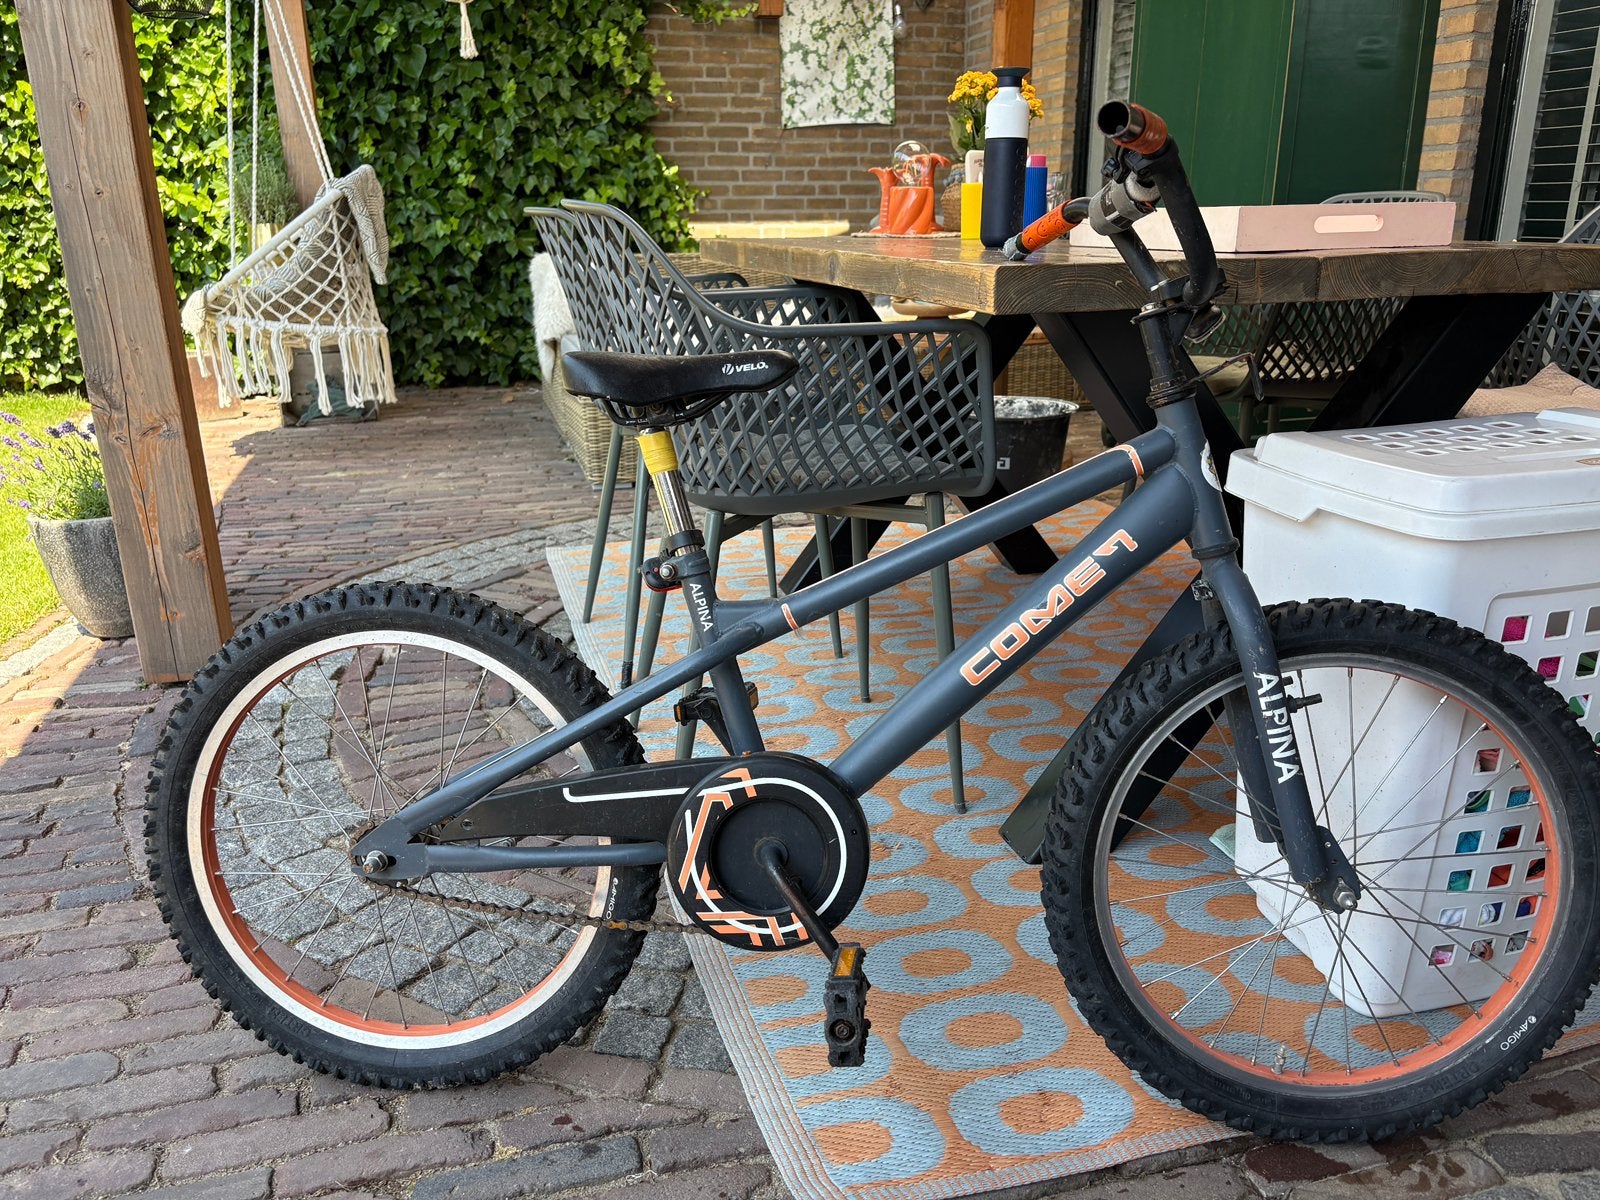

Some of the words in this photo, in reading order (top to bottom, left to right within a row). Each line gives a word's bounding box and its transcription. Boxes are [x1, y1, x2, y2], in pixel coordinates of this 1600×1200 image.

[735, 361, 767, 373] VELO
[689, 583, 714, 633] ALPINA
[1252, 671, 1300, 784] ALPINA
[605, 884, 618, 919] AMIGO
[1500, 1019, 1529, 1051] AMIGO
